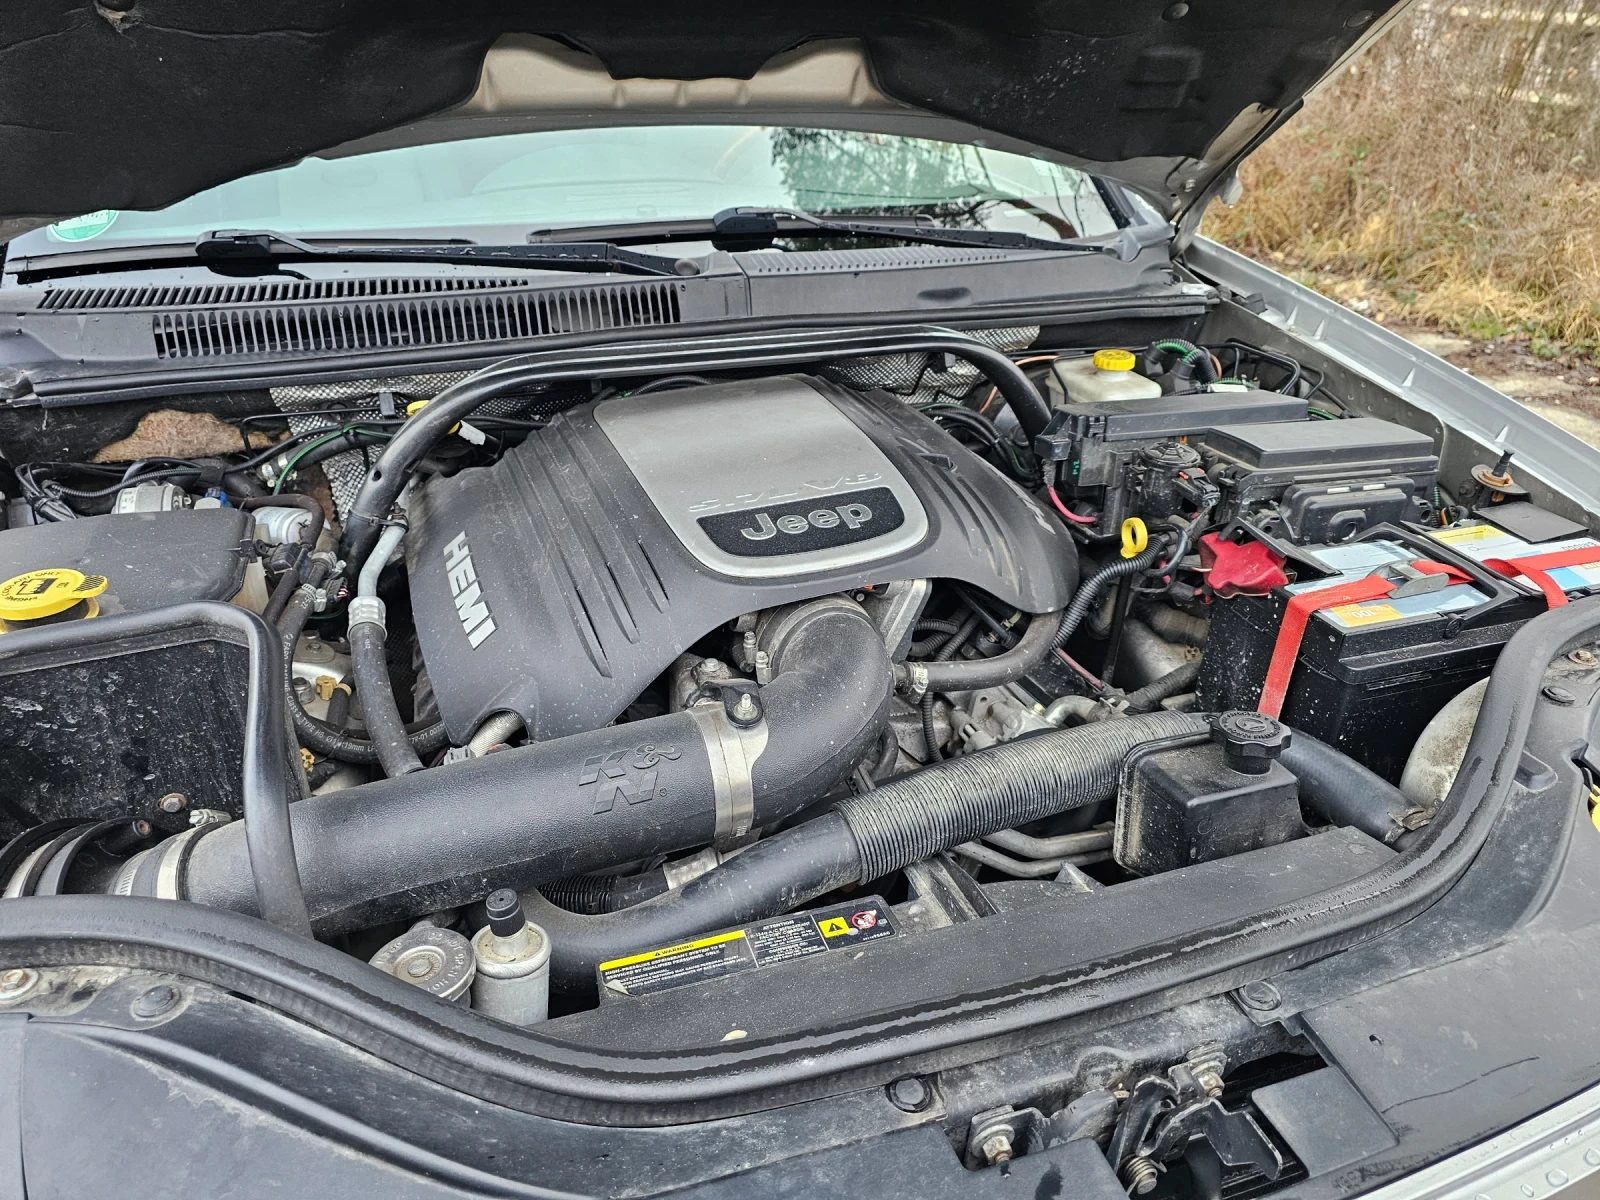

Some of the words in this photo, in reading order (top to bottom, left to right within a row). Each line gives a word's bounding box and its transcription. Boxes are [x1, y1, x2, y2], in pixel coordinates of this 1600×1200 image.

[740, 503, 873, 540] Jeep
[443, 530, 498, 650] HEMI
[1351, 609, 1377, 618] 100
[579, 743, 682, 815] K&N
[762, 920, 795, 931] ATTENTION
[661, 944, 694, 955] WARNING
